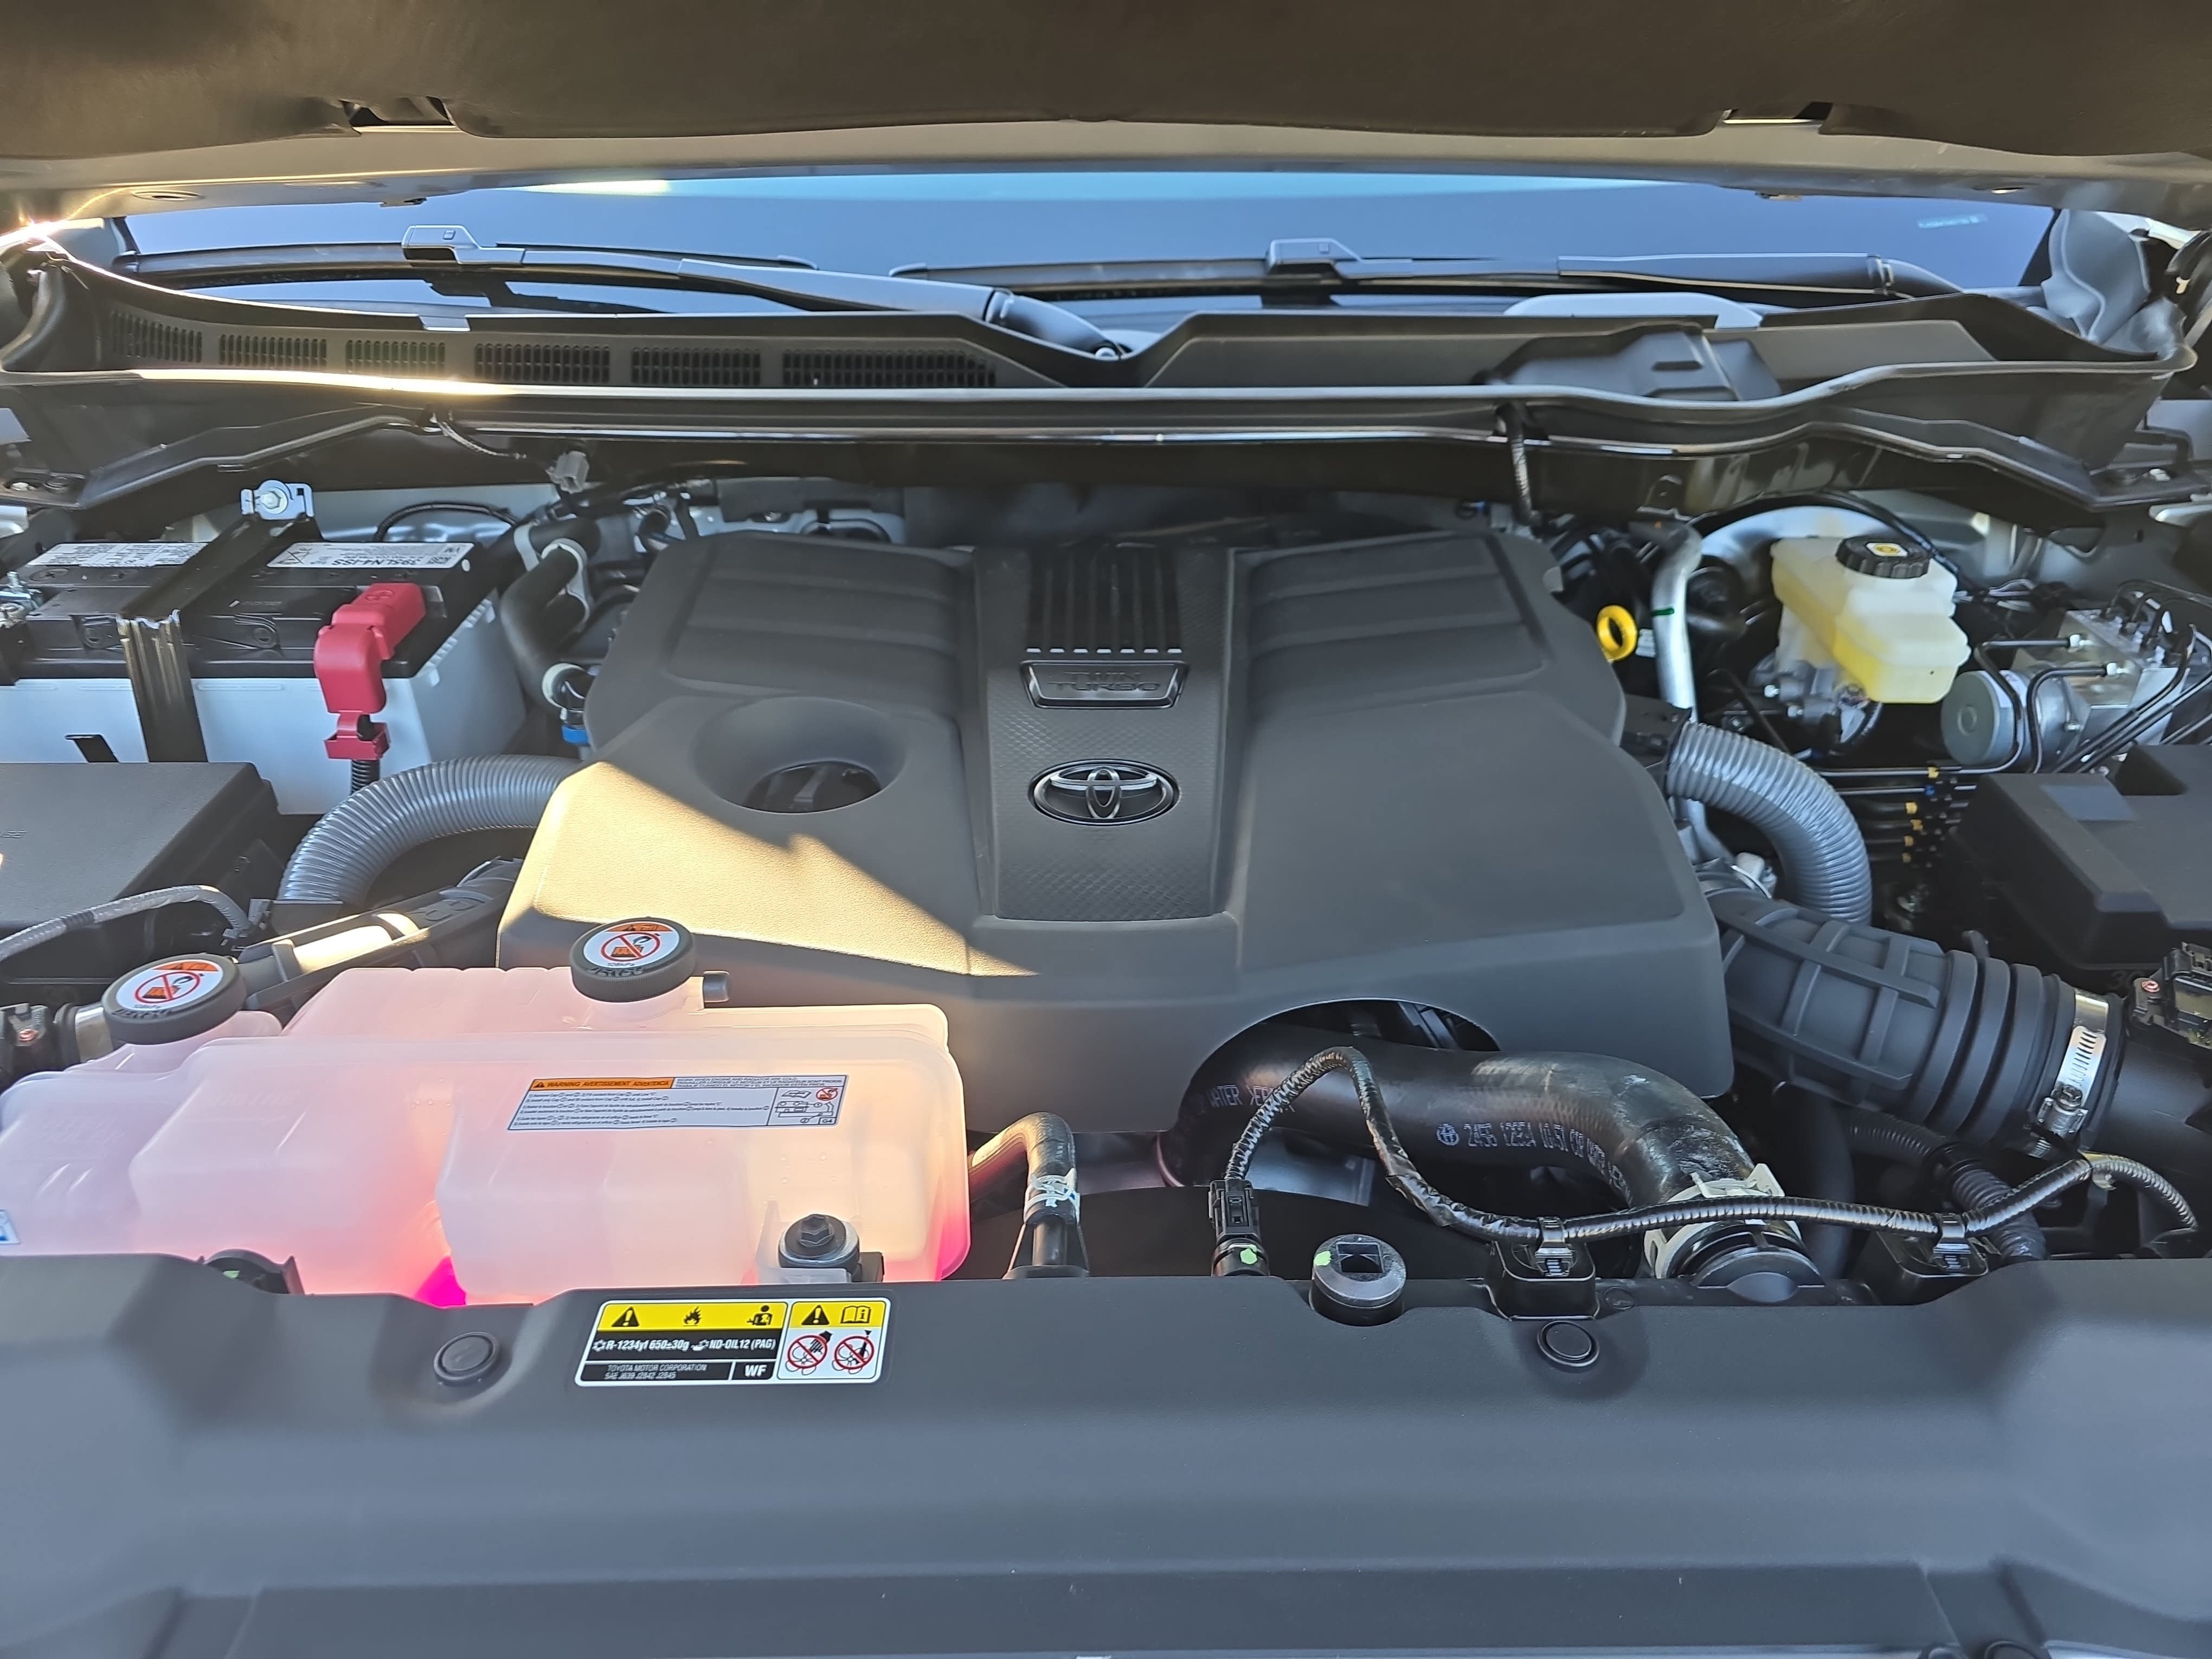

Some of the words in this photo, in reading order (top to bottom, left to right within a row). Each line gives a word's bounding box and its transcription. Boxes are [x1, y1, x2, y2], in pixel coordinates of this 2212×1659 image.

[1063, 671, 1141, 681] TWIN
[1047, 681, 1161, 691] TURBO
[605, 1340, 650, 1352] R-1234yf
[648, 1339, 690, 1352] 650±30g
[750, 1338, 776, 1351] (PAG)
[659, 1363, 708, 1372] CORPORATION
[744, 1364, 768, 1377] WF
[604, 1372, 619, 1380] SAE
